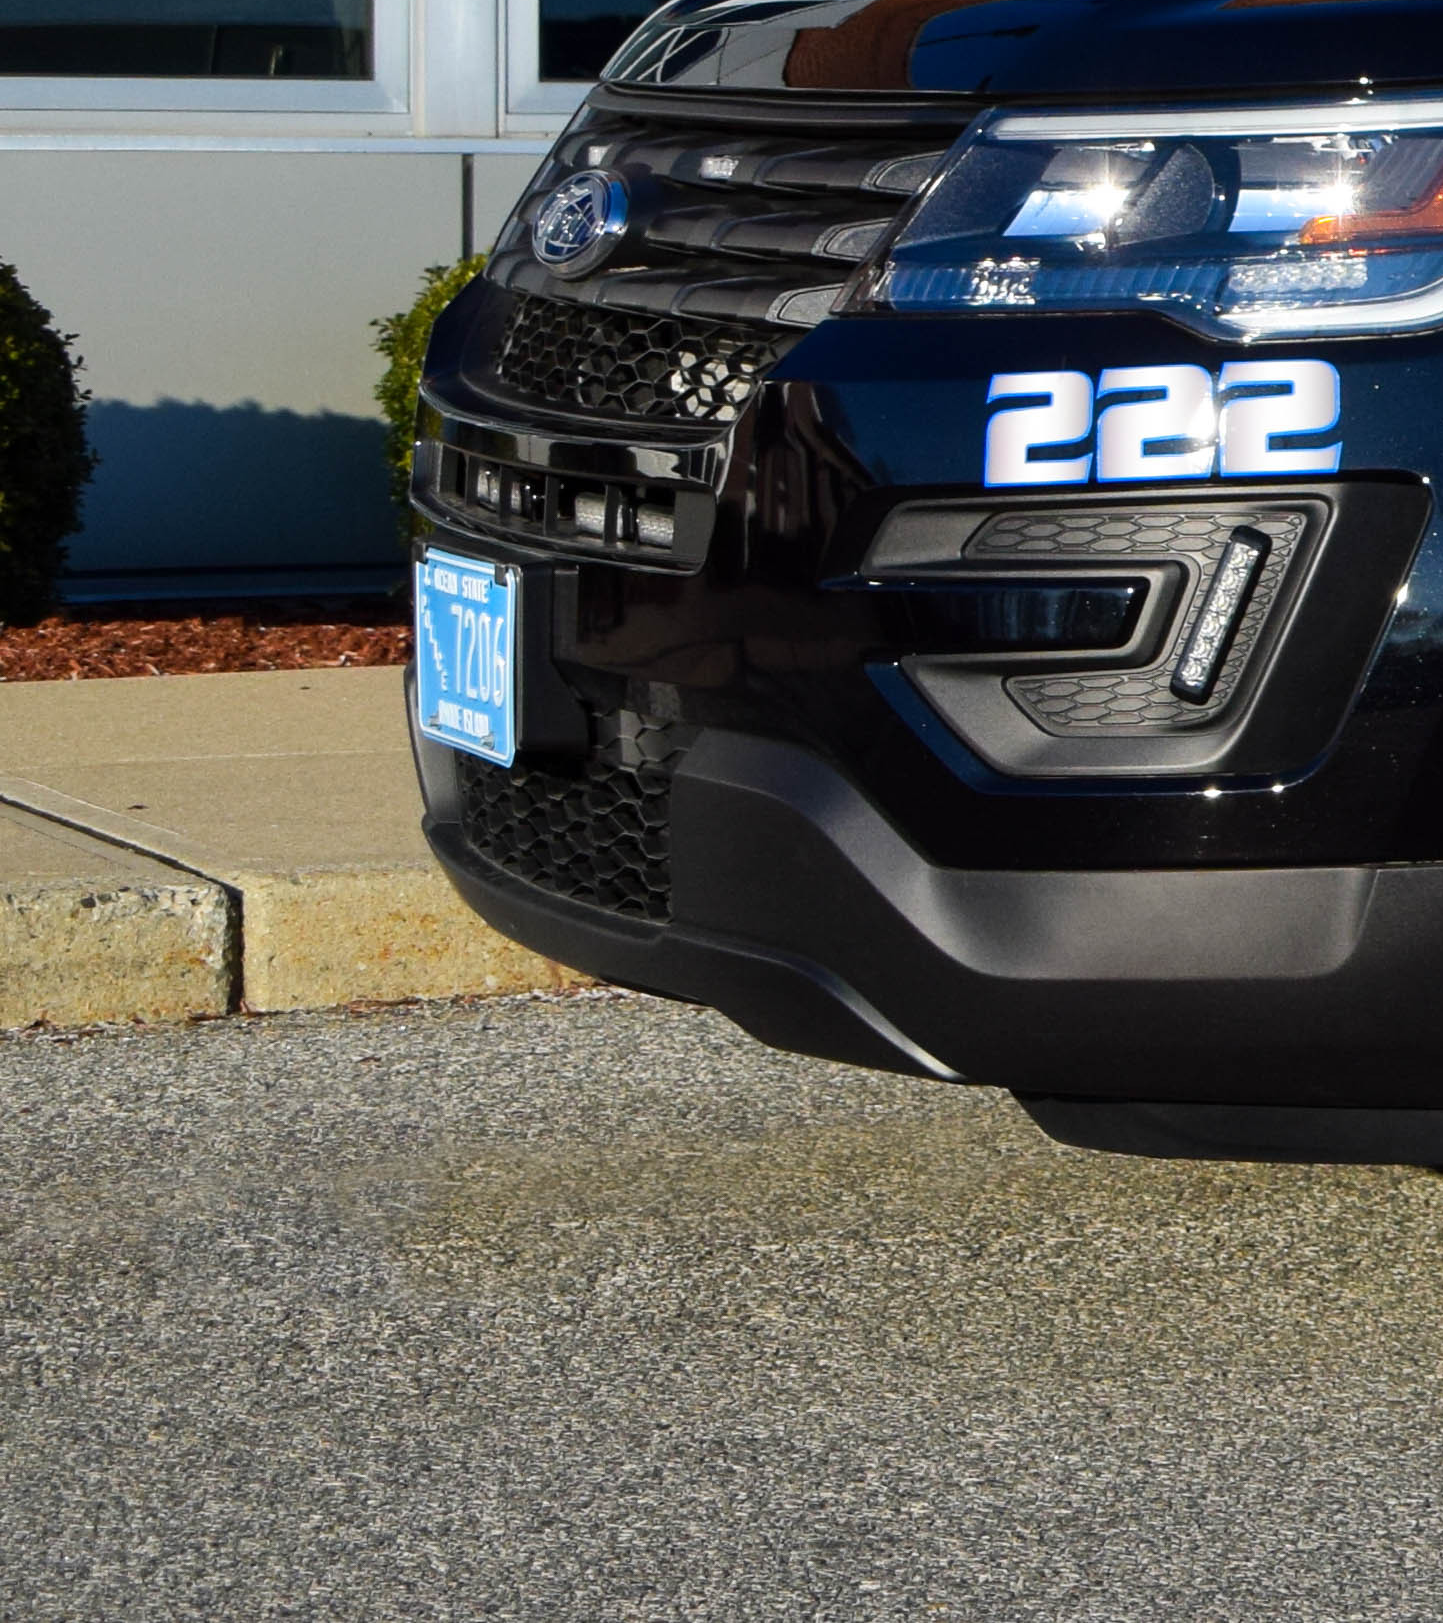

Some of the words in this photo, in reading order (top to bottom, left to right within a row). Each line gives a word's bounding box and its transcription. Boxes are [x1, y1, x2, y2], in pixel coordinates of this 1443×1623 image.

[984, 359, 1342, 488] 222
[462, 576, 490, 604] STATE
[450, 604, 506, 708] 7206
